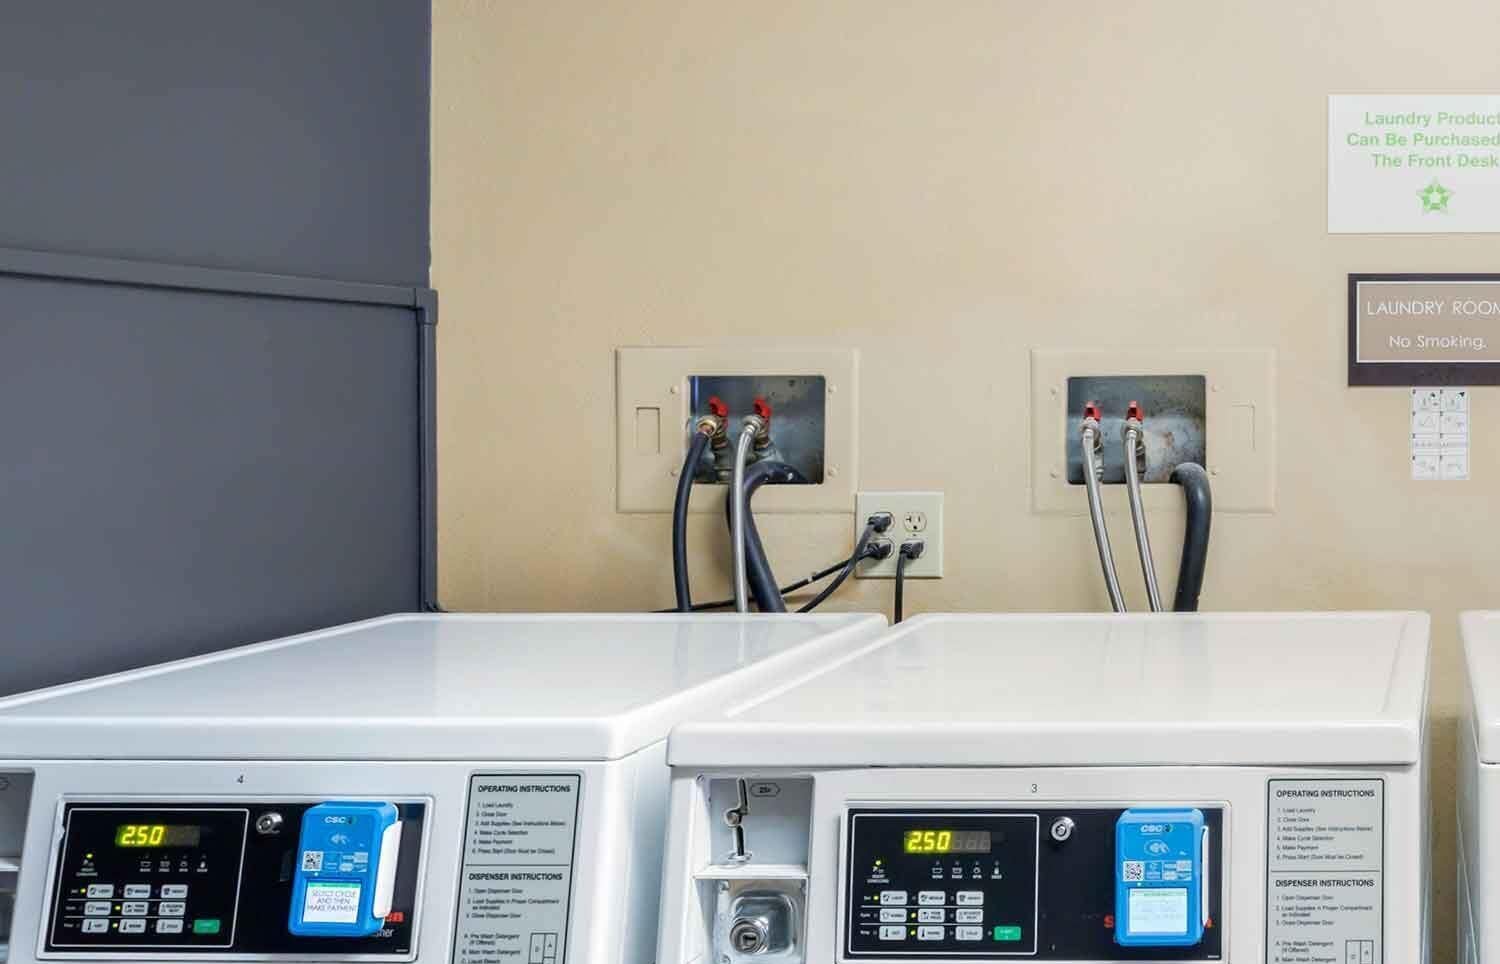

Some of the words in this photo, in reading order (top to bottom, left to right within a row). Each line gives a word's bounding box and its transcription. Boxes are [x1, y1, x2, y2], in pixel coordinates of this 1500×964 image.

[1364, 111, 1432, 127] Laundry
[1346, 132, 1380, 147] Can
[1385, 132, 1408, 147] Be
[1413, 132, 1500, 147] Purchased
[1371, 153, 1402, 168] The
[1408, 153, 1452, 168] Front
[1458, 153, 1499, 168] Desk
[1367, 300, 1445, 316] LAUNDRY
[1389, 335, 1411, 349] No
[1416, 335, 1487, 350] Smoking.
[1031, 783, 1038, 794] 3
[1276, 789, 1319, 797] OPERATING
[1320, 789, 1375, 797] INSTRUCTIONS
[324, 816, 347, 824] CSC
[121, 826, 165, 846] 2.50
[907, 831, 951, 851] 2.50
[468, 873, 509, 881] DISPENSER
[510, 873, 563, 881] INSTRUCTIONS
